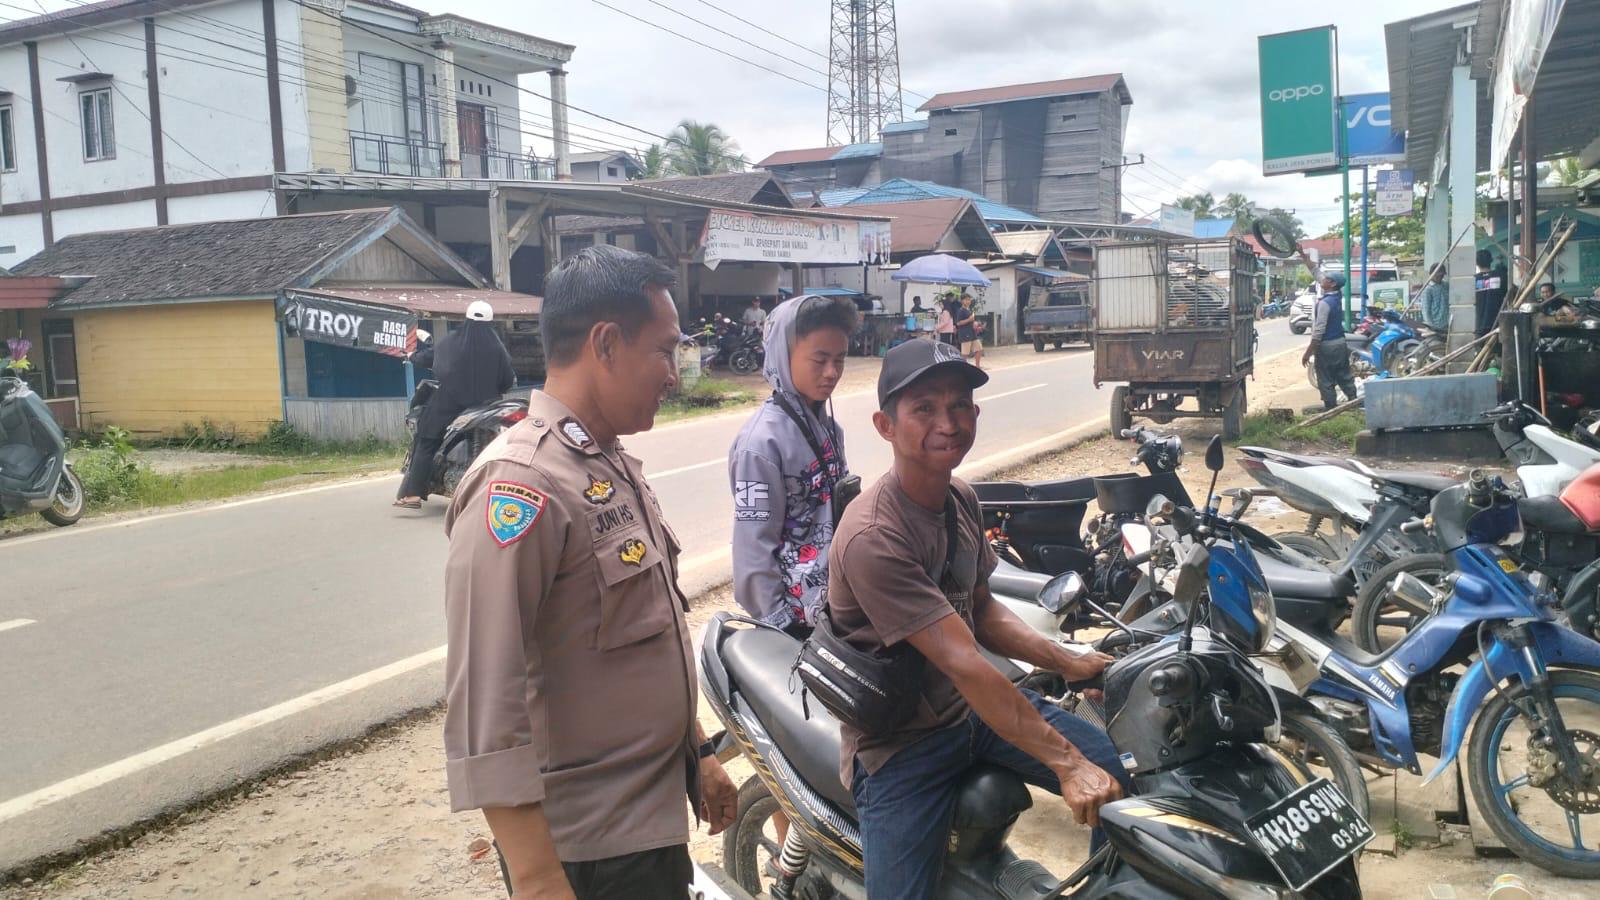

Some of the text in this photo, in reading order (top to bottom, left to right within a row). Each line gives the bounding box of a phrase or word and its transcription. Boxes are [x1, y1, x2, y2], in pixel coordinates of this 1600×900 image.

[1269, 84, 1324, 102] oppo
[305, 307, 364, 339] TROY
[382, 320, 407, 336] RASA
[373, 331, 407, 349] BERANI
[1141, 350, 1185, 360] VIAR
[495, 485, 540, 502] BINMAS
[1369, 674, 1396, 700] YAMAHA
